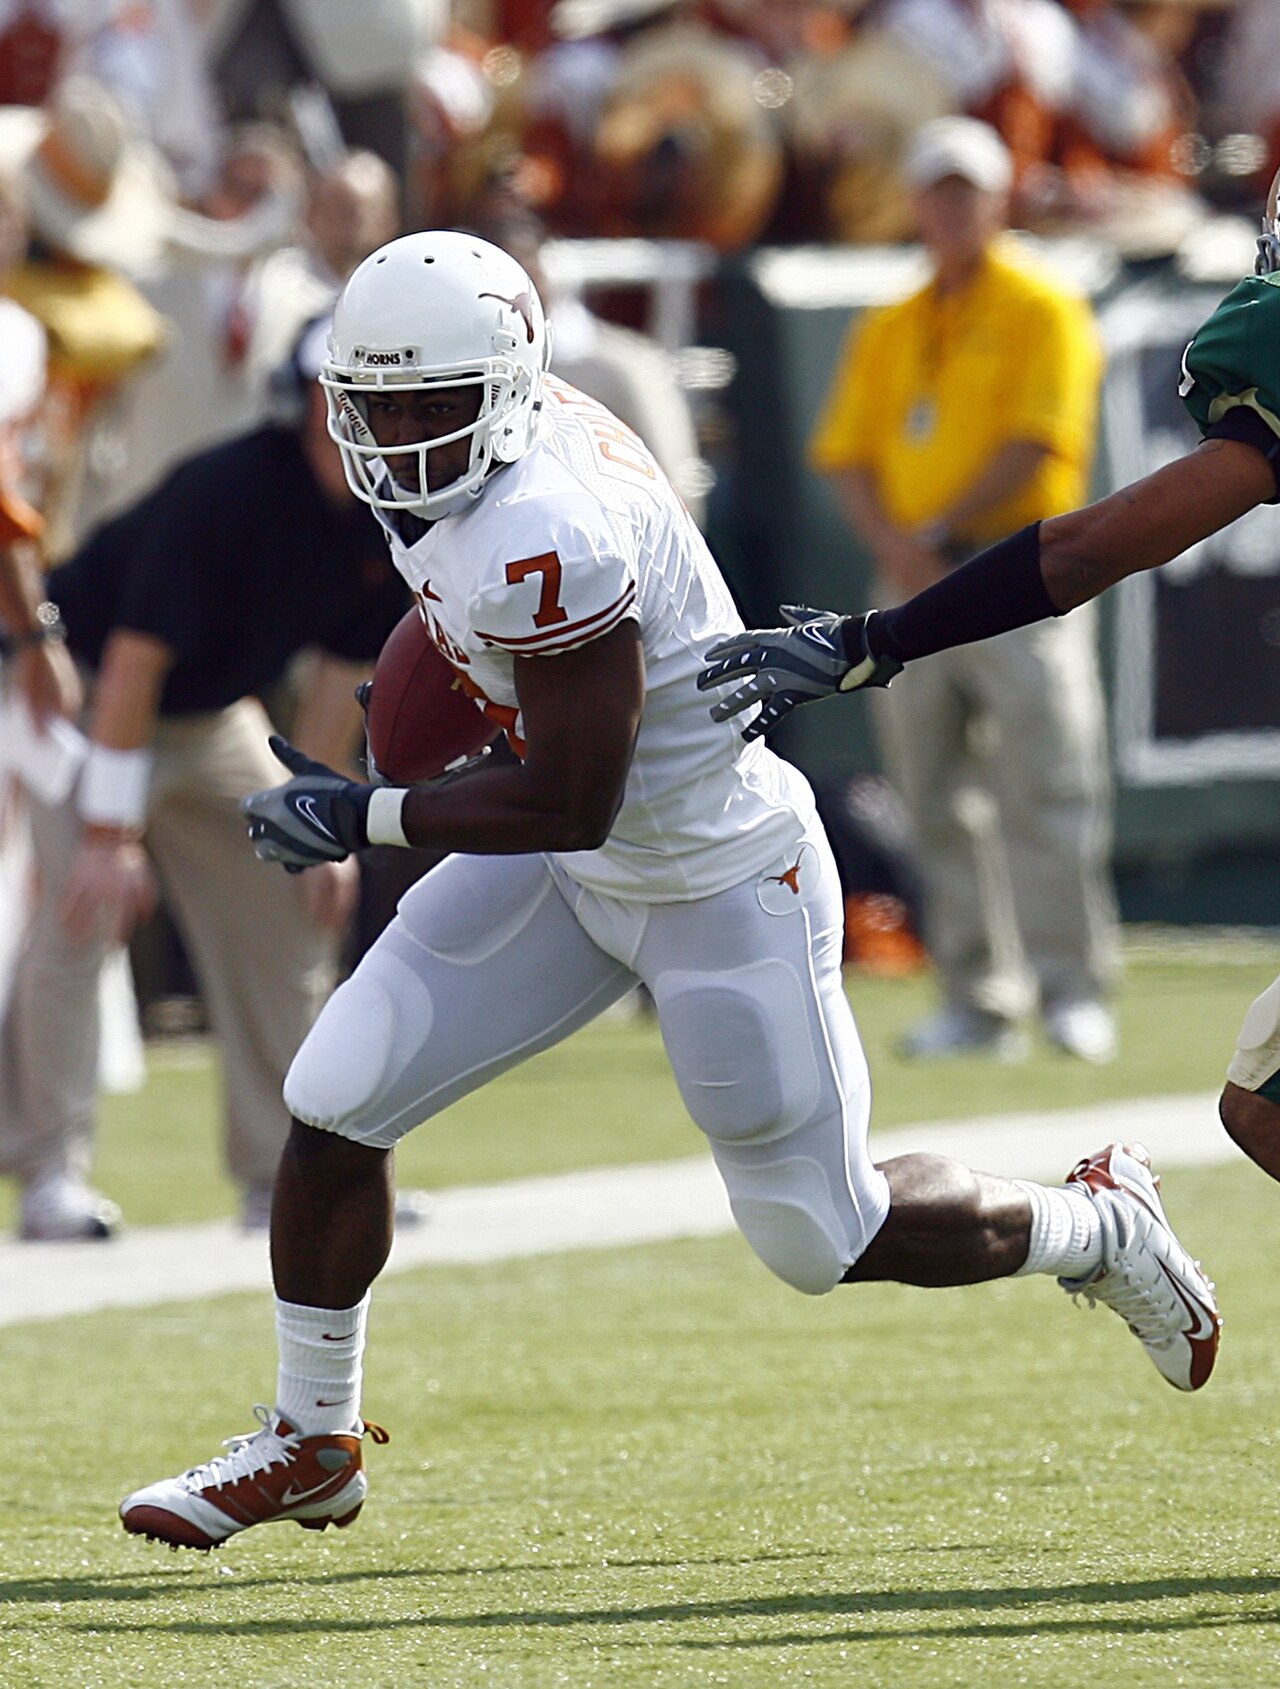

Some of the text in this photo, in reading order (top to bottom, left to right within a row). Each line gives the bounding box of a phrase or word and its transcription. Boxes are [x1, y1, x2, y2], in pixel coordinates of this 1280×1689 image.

[366, 353, 400, 365] HORNS
[338, 392, 368, 437] Riddell
[505, 550, 569, 629] 7
